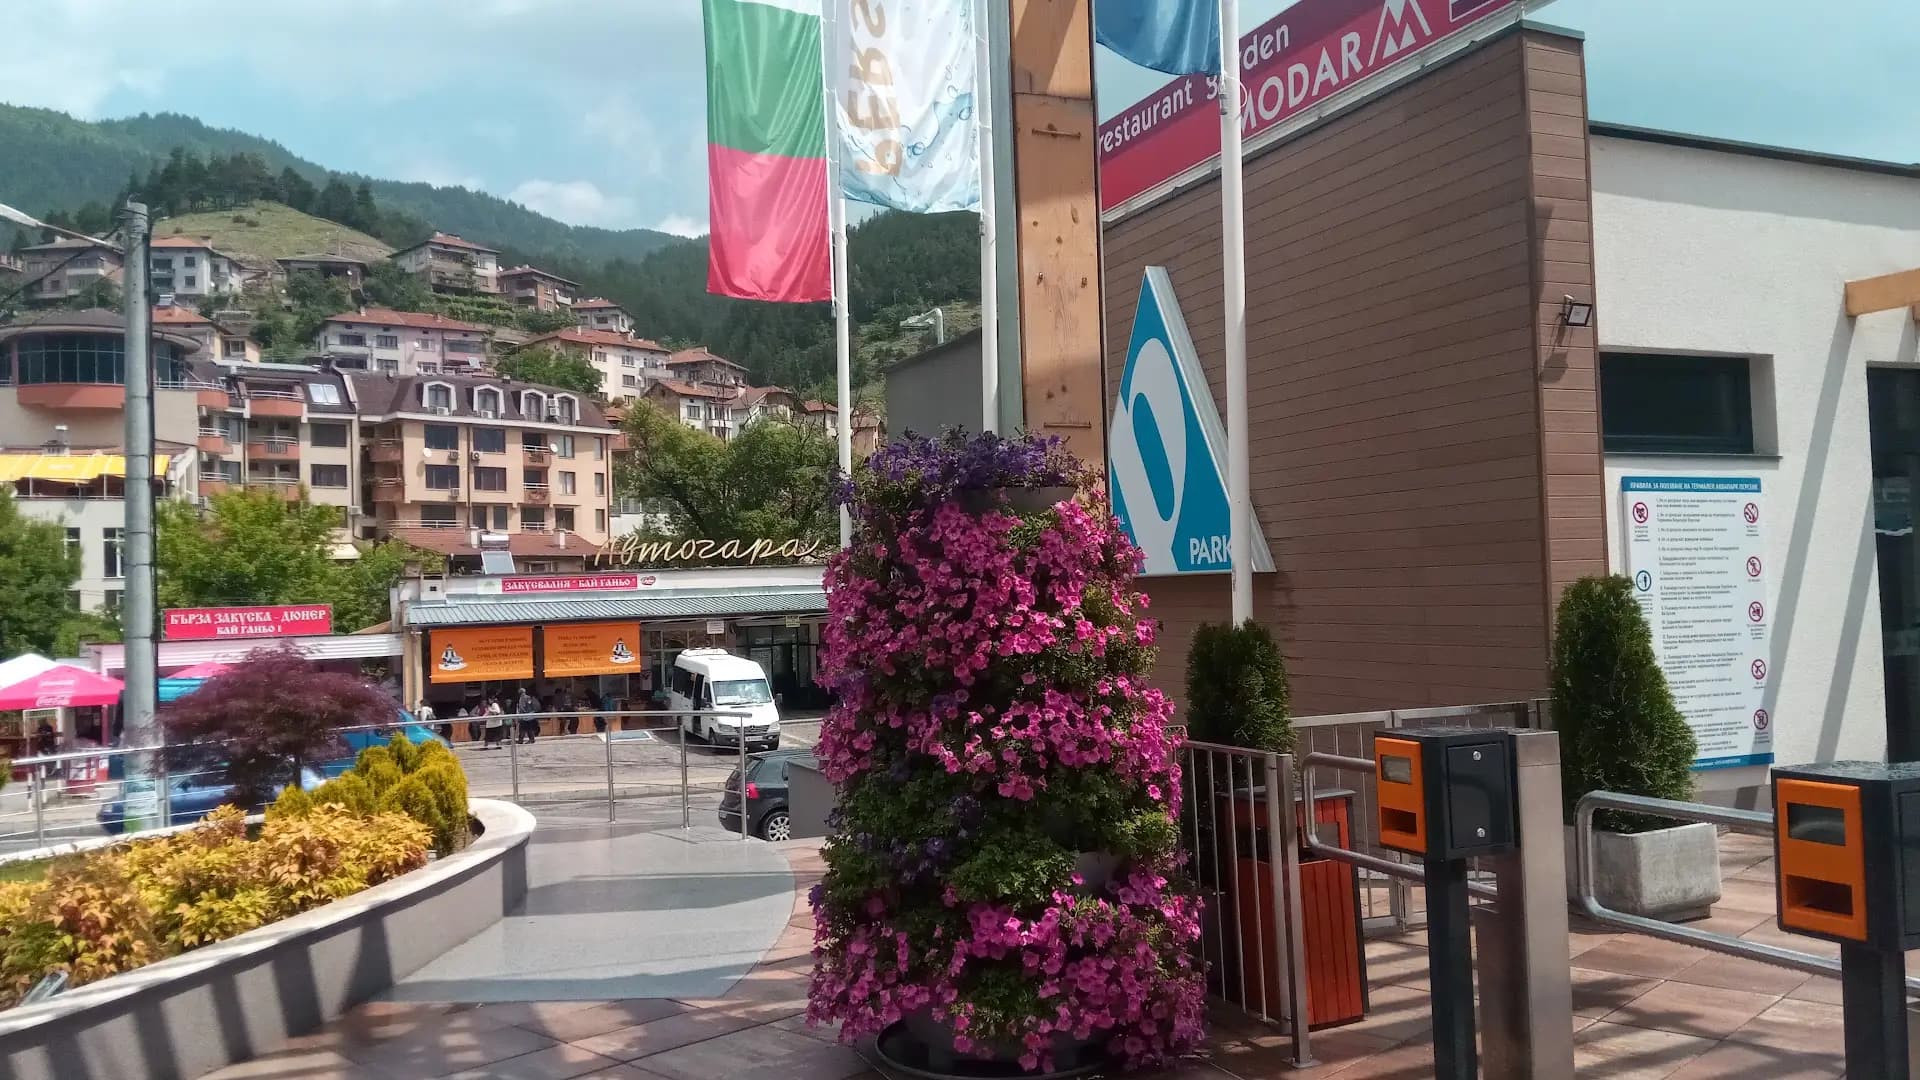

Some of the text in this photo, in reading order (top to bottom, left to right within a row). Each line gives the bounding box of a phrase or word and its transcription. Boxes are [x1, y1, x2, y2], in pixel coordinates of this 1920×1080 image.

[1098, 78, 1194, 157] restaurant
[594, 535, 821, 565] Автогара
[170, 613, 212, 625] БЪРЗА
[214, 611, 272, 625] ЗАКУСКА
[216, 624, 239, 635] БАЙ
[240, 624, 276, 634] ГАНЬО
